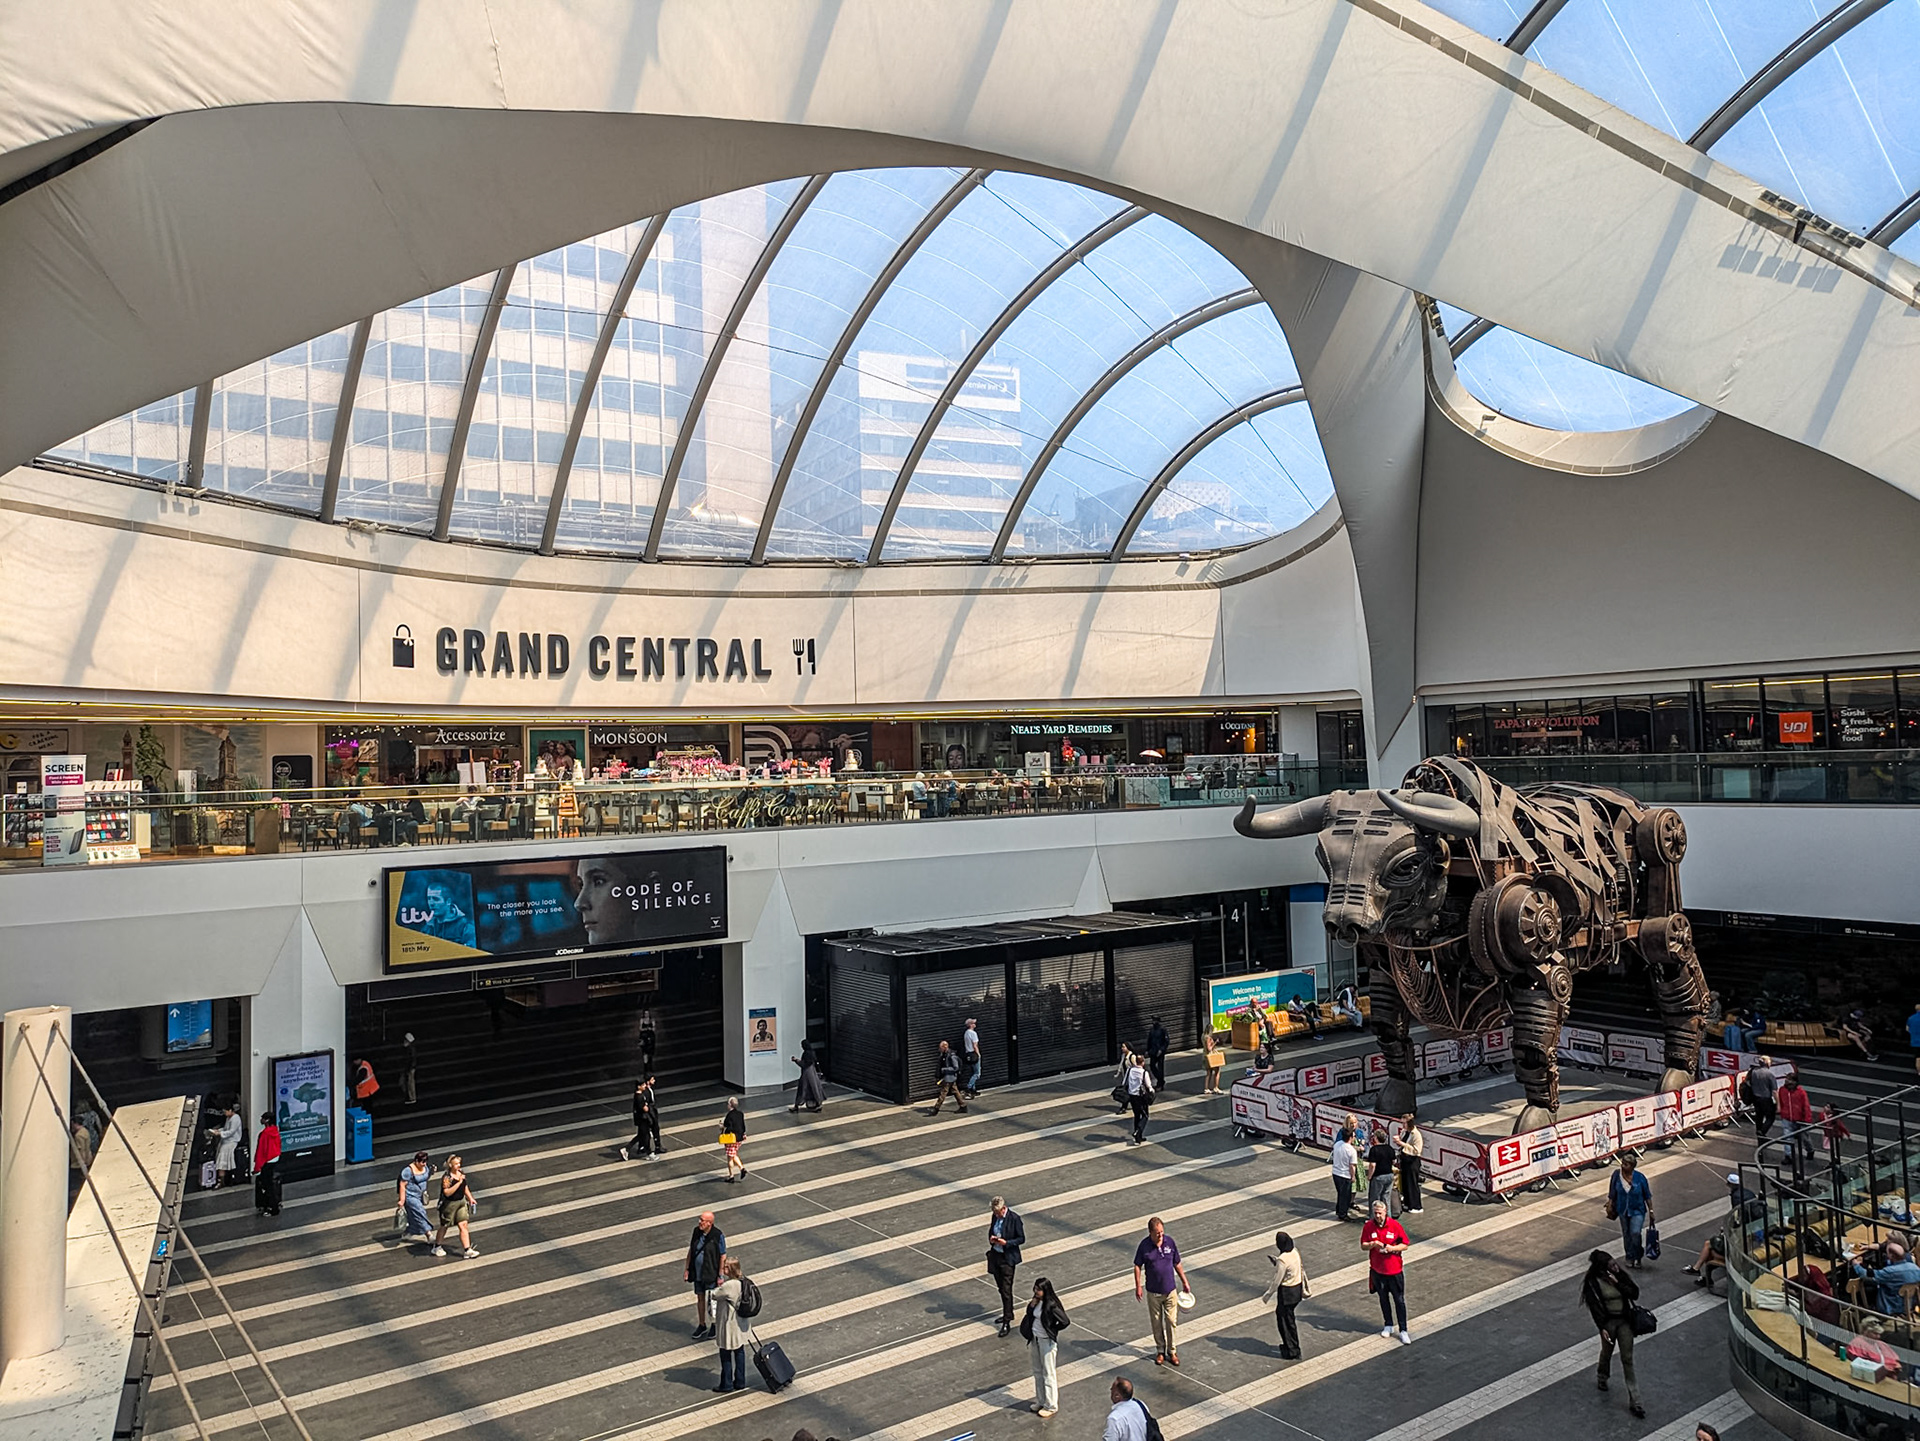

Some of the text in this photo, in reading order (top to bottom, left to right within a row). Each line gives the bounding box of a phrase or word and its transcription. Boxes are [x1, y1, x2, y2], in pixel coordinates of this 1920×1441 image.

[436, 626, 774, 679] GRAND CENTRAL
[1841, 709, 1866, 717] Sushi
[1493, 715, 1600, 729] TAPAS REVOLUTION
[1783, 721, 1808, 733] YO!
[435, 727, 506, 744] Accessorize
[1010, 724, 1113, 735] NEAL'S YARD REMEDIES
[1842, 725, 1886, 736] Japanese
[594, 732, 668, 744] MONSOON
[45, 763, 84, 773] SCREEN
[1258, 787, 1285, 796] NAILS
[764, 793, 838, 818] Concerto
[611, 880, 694, 898] CODE OF
[502, 901, 525, 909] closer
[527, 900, 540, 908] you
[631, 893, 711, 911] SILENCE
[401, 907, 435, 924] itv
[1231, 908, 1239, 922] 4
[555, 948, 584, 956] JCDecaux
[1232, 986, 1255, 996] Welcome
[1217, 996, 1249, 1006] Birmingham
[1261, 991, 1276, 999] Street
[283, 1076, 310, 1084] anywhere
[295, 1134, 322, 1143] trainline
